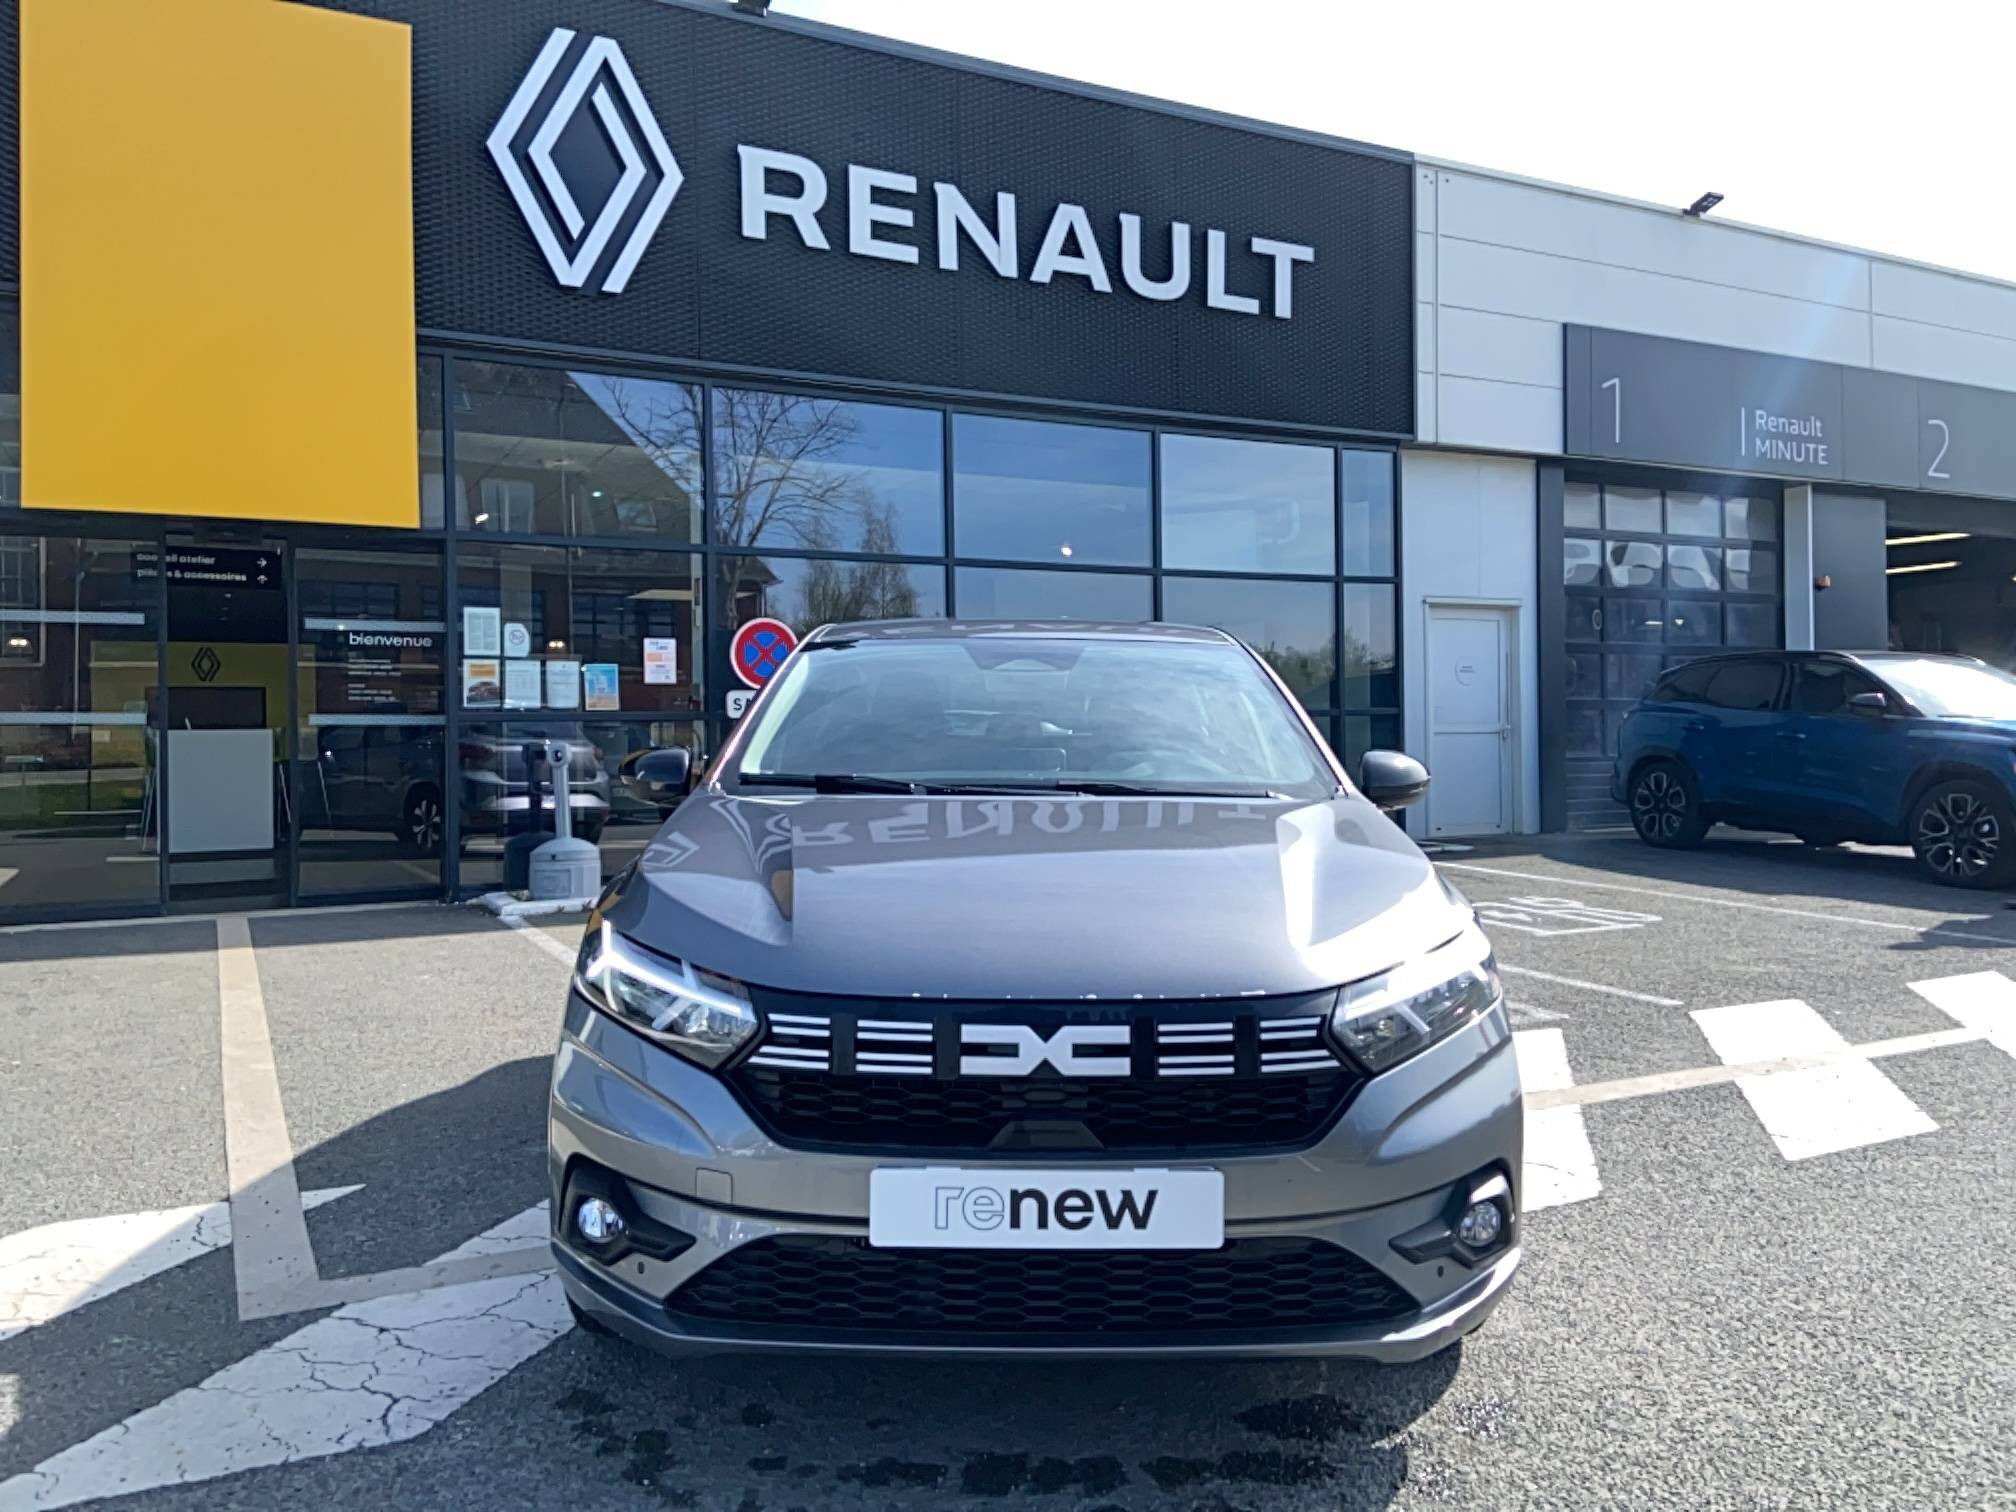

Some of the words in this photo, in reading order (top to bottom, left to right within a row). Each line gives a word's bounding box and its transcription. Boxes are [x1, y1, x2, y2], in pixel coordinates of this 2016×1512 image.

[737, 143, 1316, 320] RENAULT
[1601, 376, 1622, 444] 1
[1754, 408, 1823, 438] Renault
[1754, 437, 1829, 466] MINUTE
[1927, 418, 1952, 479] 2
[136, 553, 178, 563] acceil
[349, 632, 432, 647] bienvenue
[934, 1186, 1159, 1231] renew
